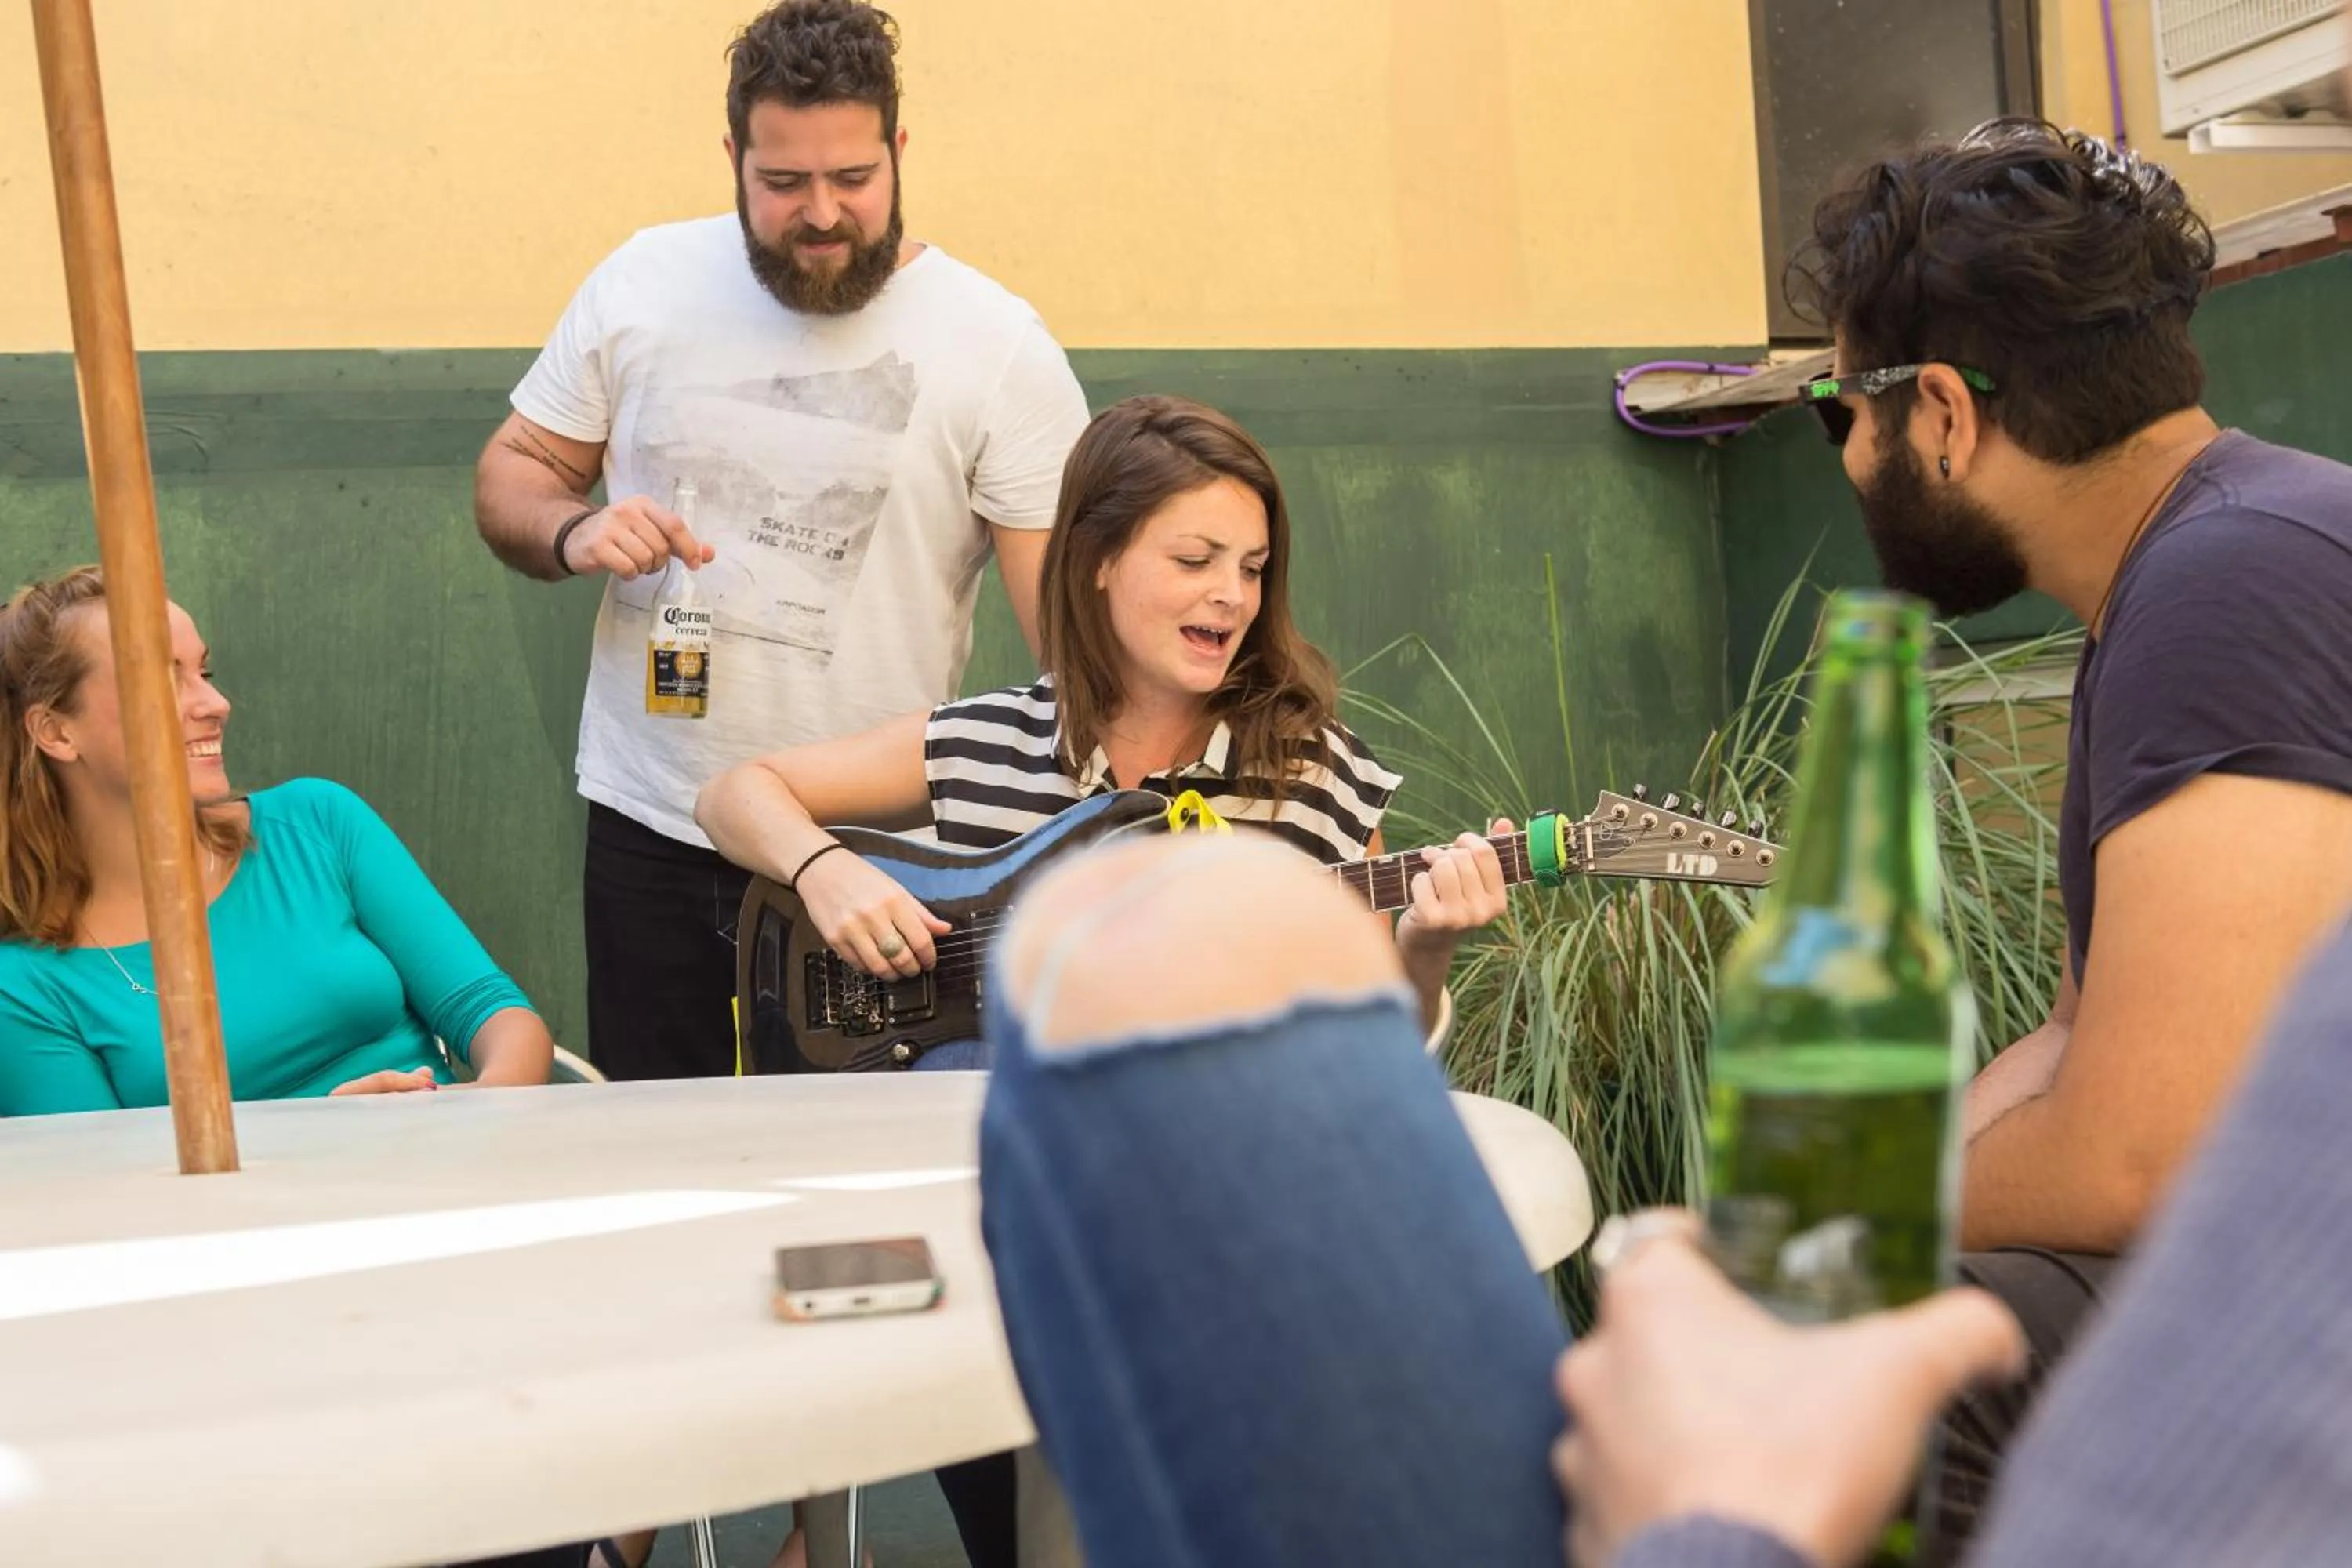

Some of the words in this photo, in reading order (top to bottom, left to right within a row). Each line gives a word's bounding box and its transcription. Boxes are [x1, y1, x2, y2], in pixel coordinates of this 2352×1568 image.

[747, 529, 779, 546] THE
[760, 517, 818, 540] SKATE
[1667, 852, 1718, 876] LTD
